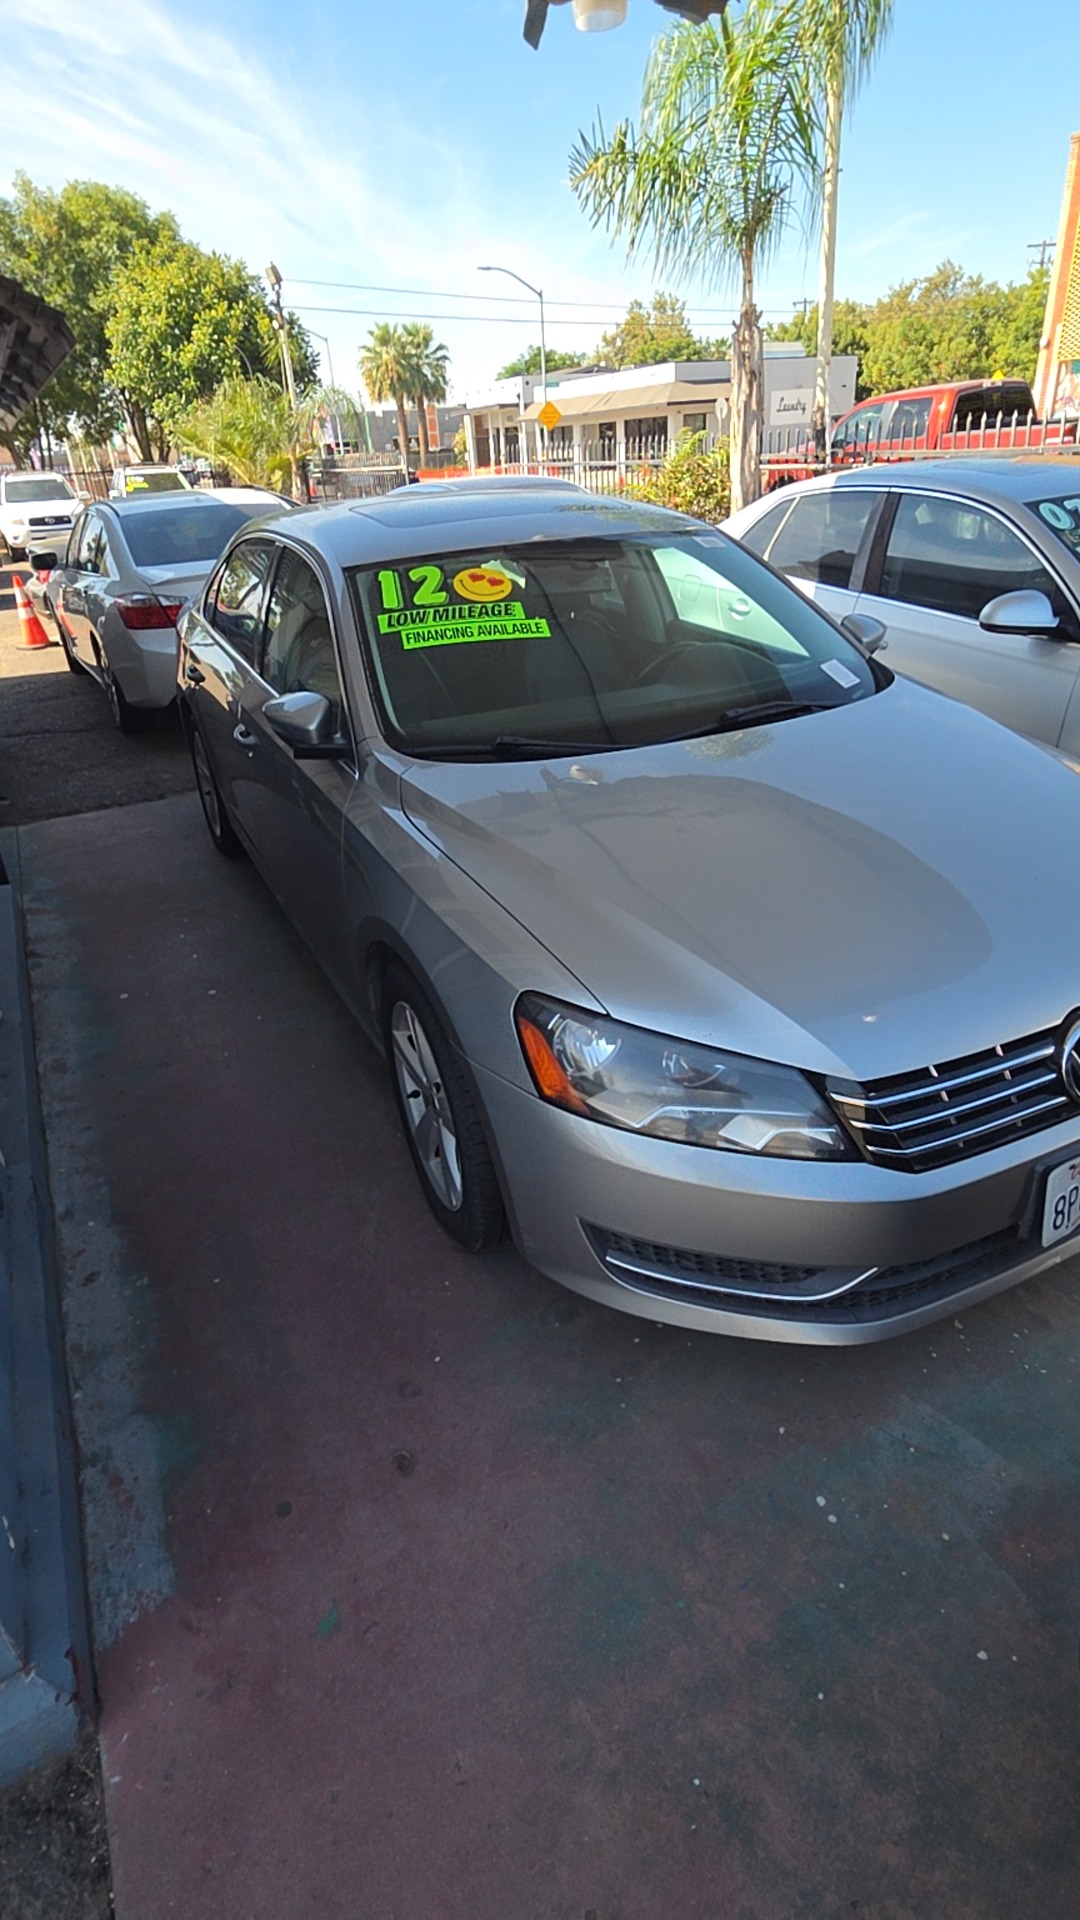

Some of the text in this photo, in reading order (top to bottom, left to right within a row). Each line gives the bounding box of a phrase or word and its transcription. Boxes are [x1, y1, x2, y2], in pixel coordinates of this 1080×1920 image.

[776, 396, 807, 415] Laundry
[377, 565, 449, 609] 12
[386, 603, 516, 629] LOW MILEAGE
[405, 621, 544, 645] FINANCING AVAILABLE
[1052, 1185, 1080, 1230] 8P
